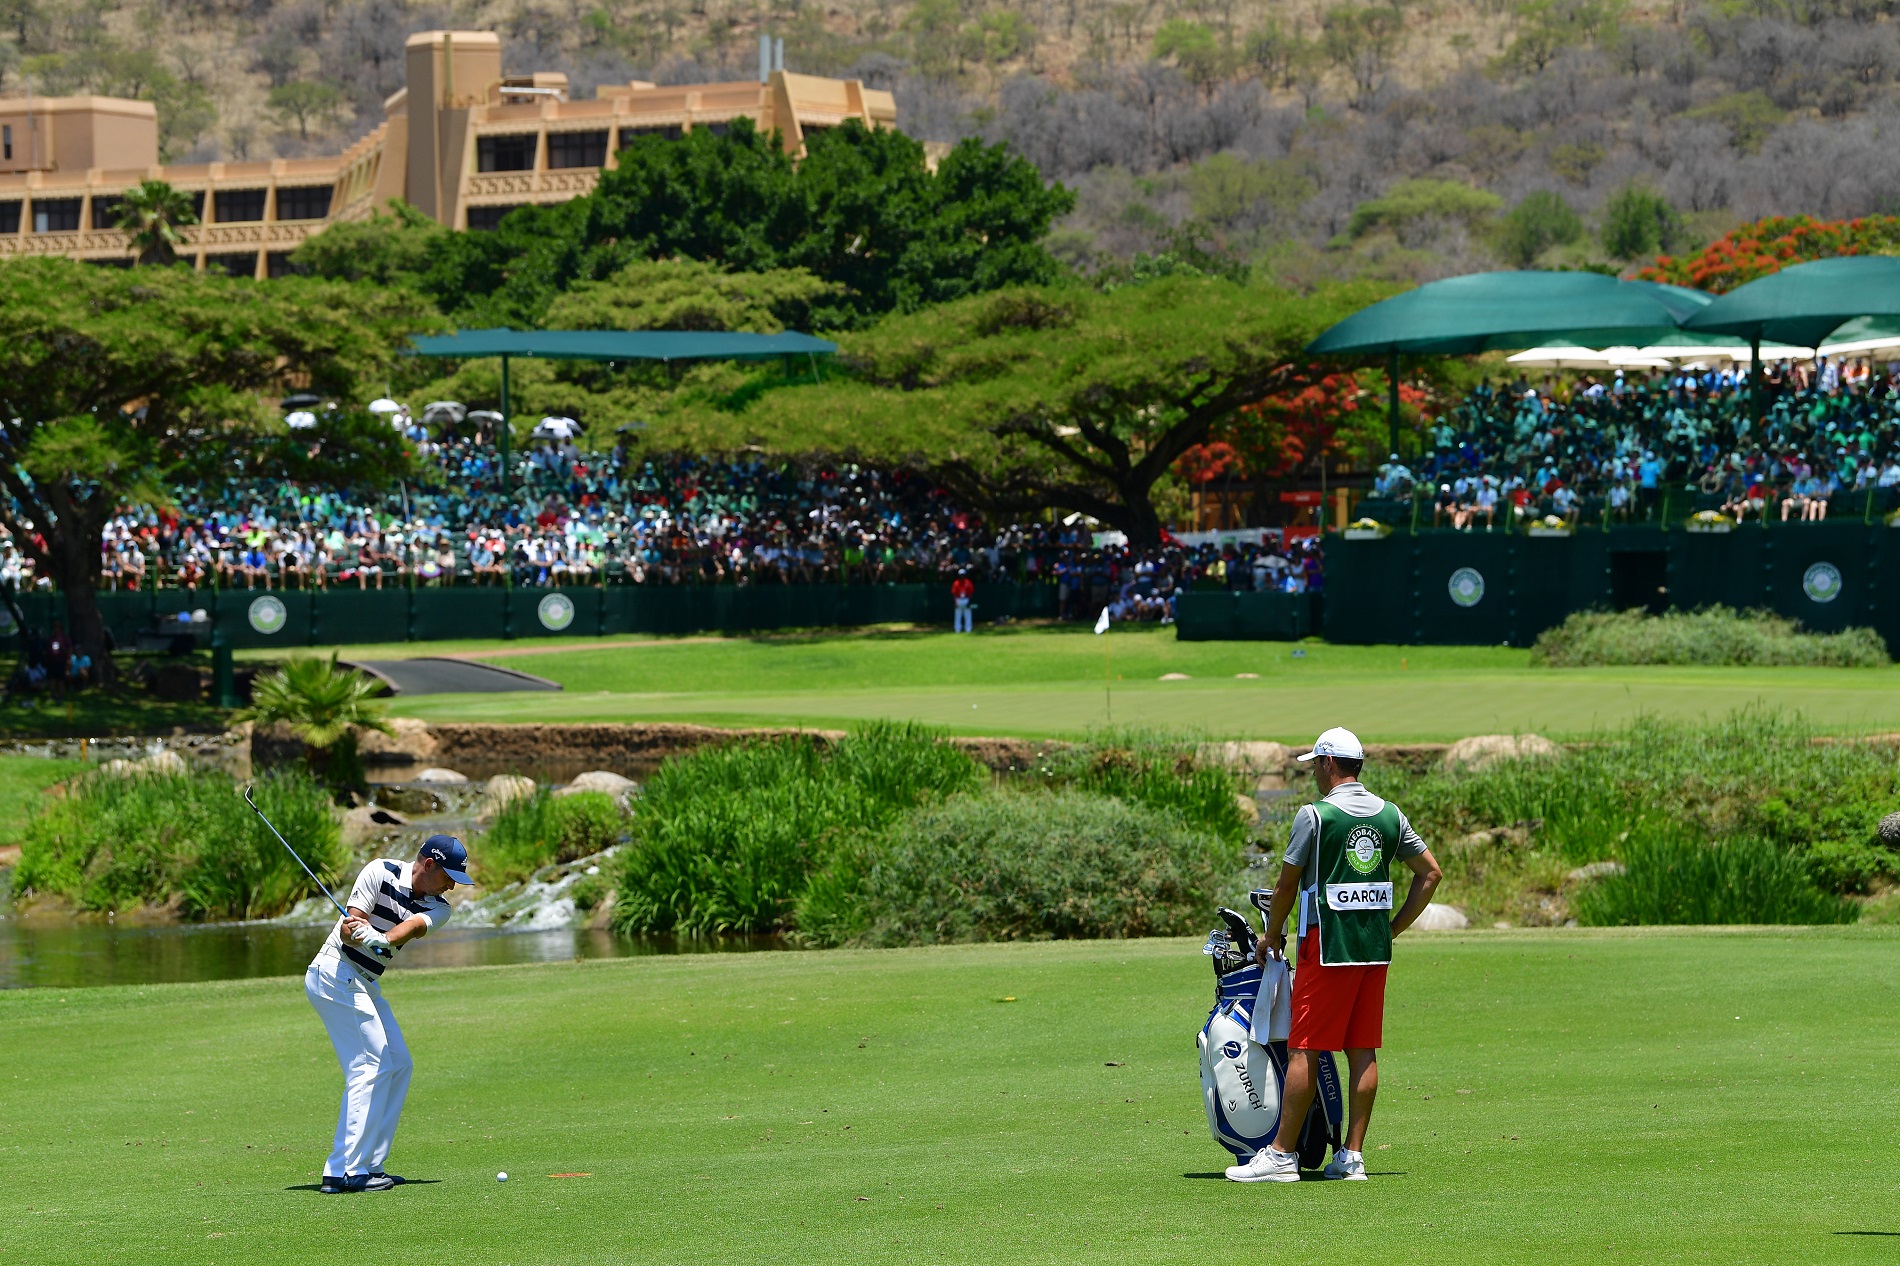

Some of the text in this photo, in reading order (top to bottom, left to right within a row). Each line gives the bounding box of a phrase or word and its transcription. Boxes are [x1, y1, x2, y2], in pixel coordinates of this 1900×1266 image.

[1349, 829, 1380, 847] NEDBANK
[1337, 890, 1388, 903] GARCIA
[1234, 1062, 1262, 1111] ZURICH
[1318, 1056, 1337, 1100] ZURICH
